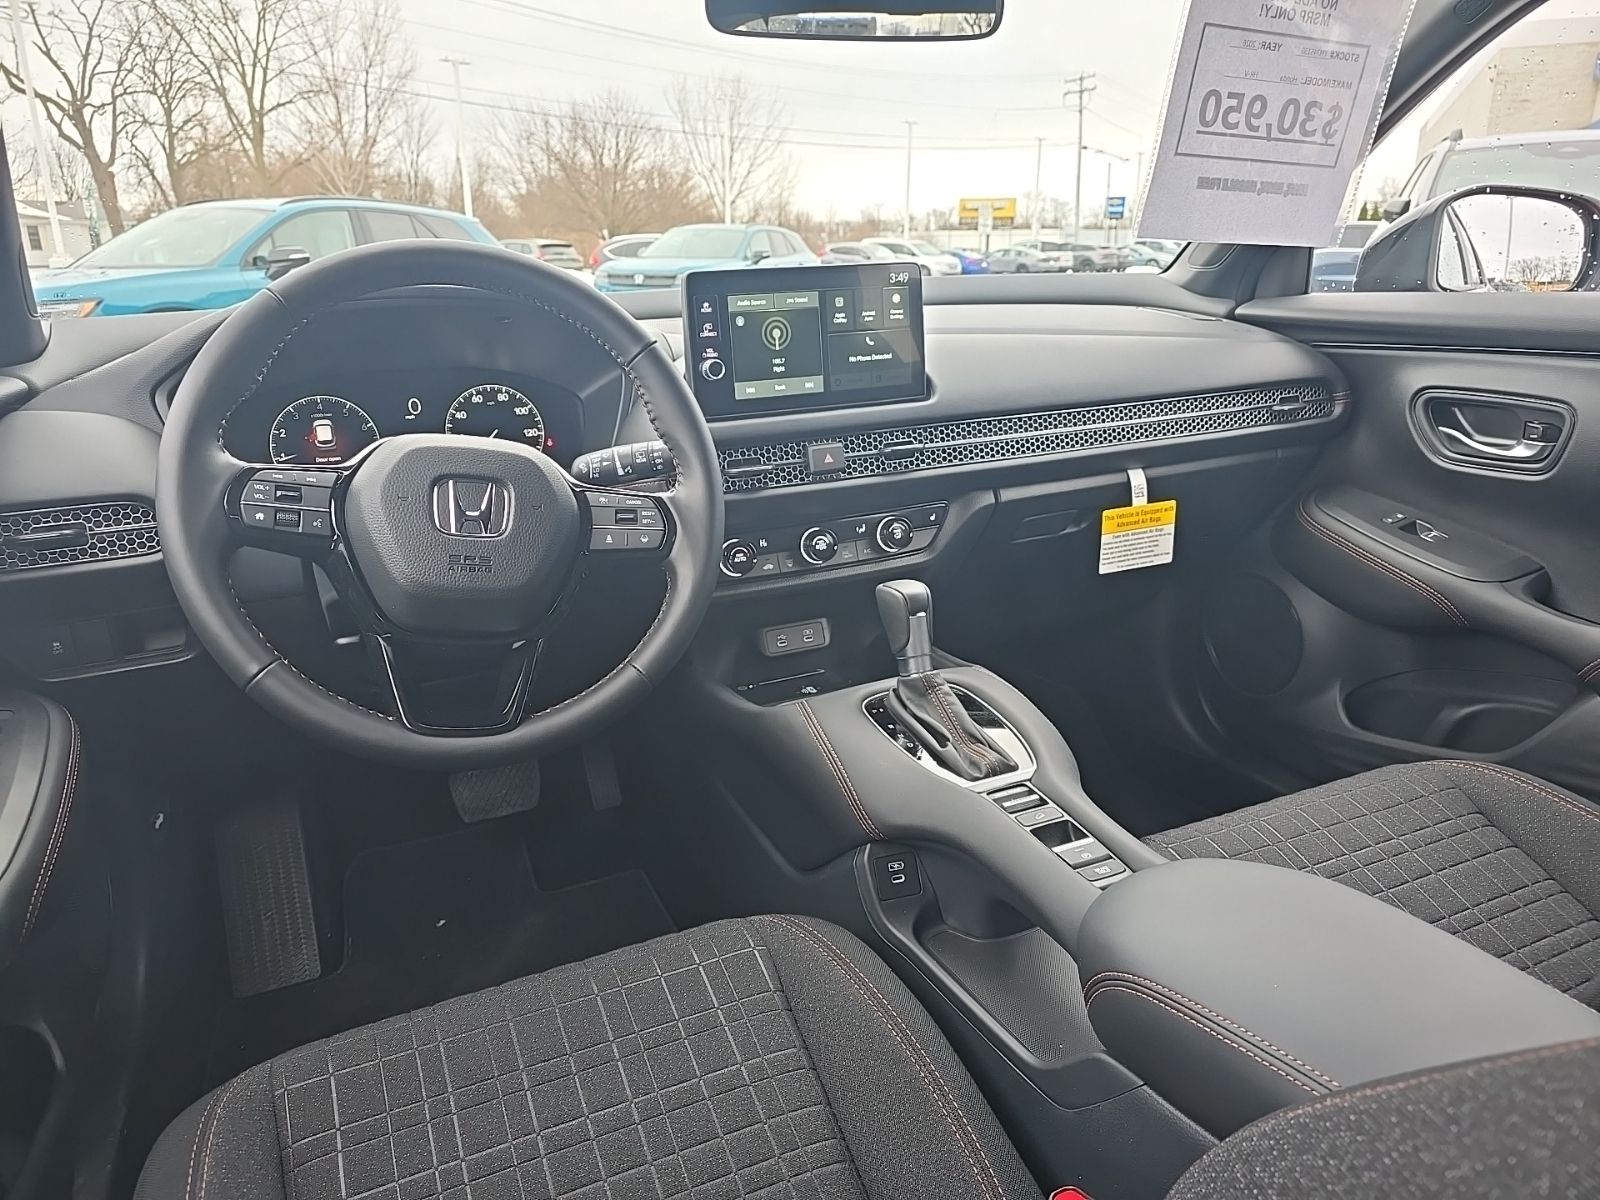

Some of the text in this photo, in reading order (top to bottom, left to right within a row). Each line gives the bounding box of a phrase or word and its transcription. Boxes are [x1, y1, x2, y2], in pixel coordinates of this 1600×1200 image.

[889, 272, 909, 284] 3:49
[471, 393, 509, 403] 60 80
[317, 403, 322, 411] 4
[407, 397, 421, 415] 0
[293, 409, 349, 420] 3 5
[454, 407, 529, 420] 40 100
[361, 423, 368, 431] 6
[523, 428, 538, 437] 120
[279, 429, 286, 437] 2
[1116, 511, 1134, 520] Vehicle
[1140, 508, 1163, 516] Equipped
[1117, 519, 1140, 528] Advanced
[1149, 516, 1161, 524] Bags
